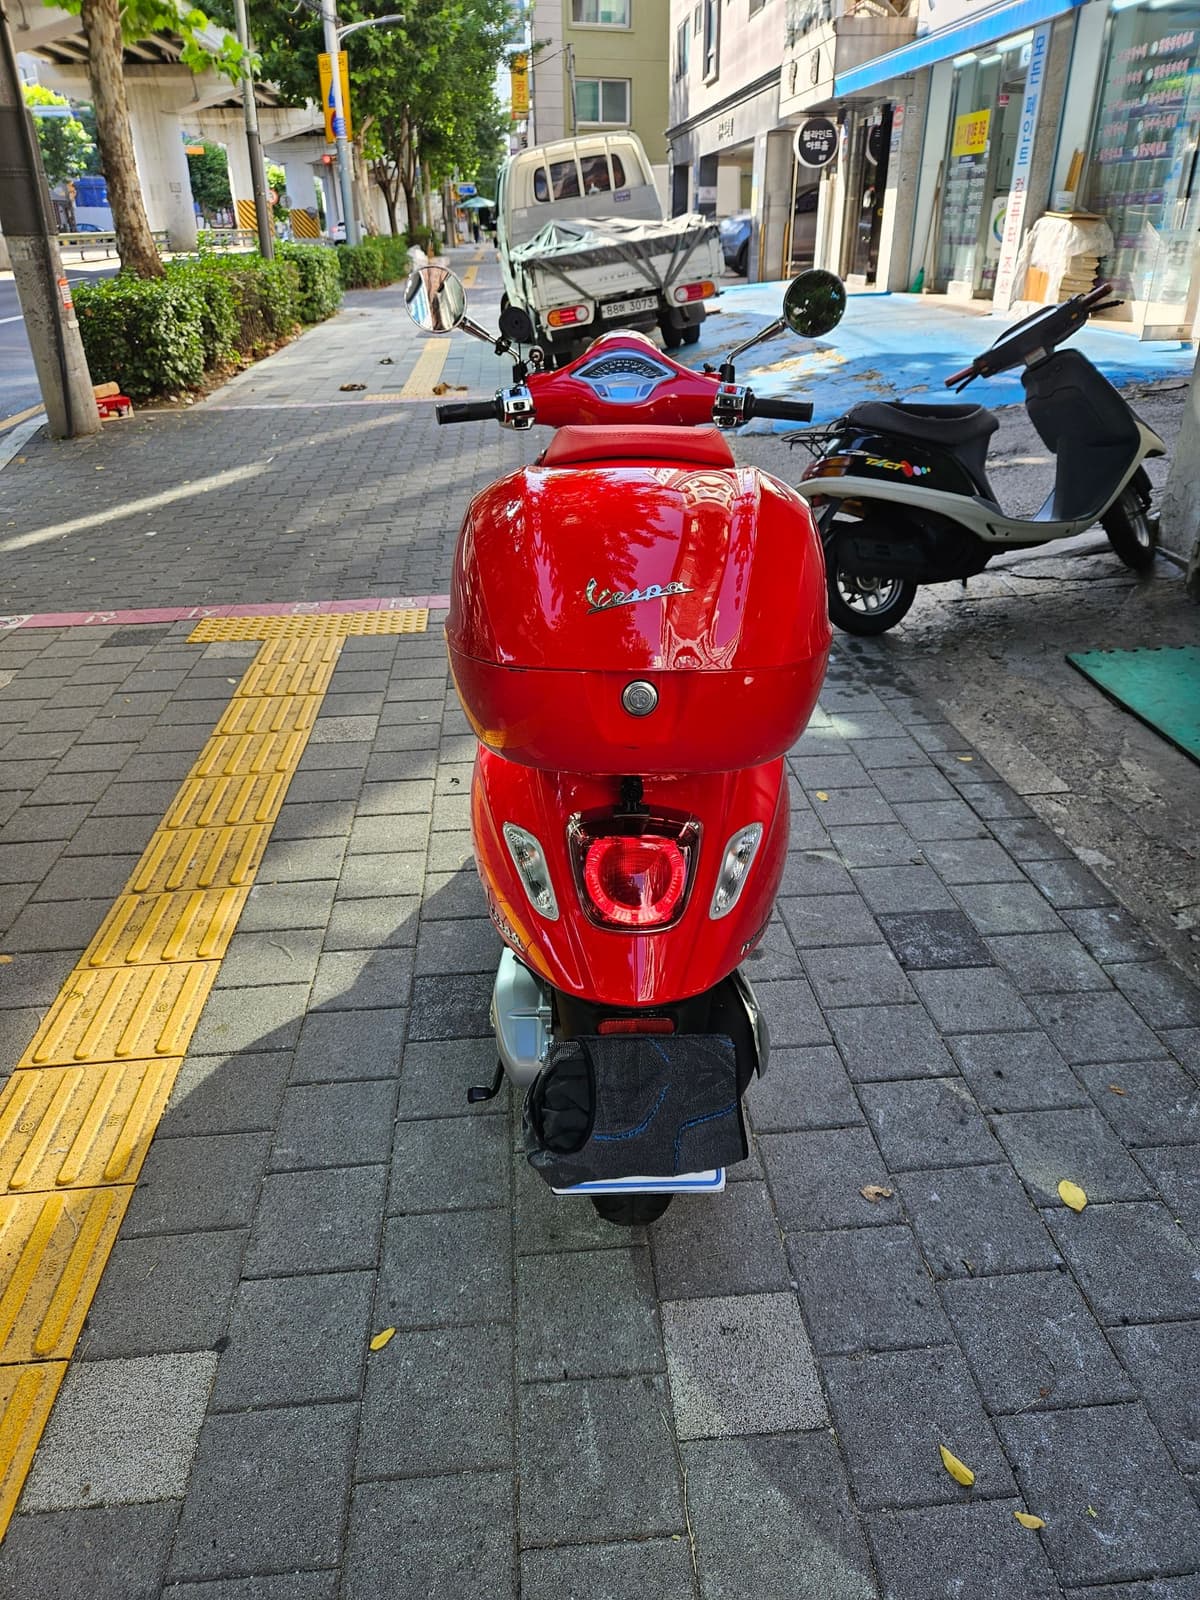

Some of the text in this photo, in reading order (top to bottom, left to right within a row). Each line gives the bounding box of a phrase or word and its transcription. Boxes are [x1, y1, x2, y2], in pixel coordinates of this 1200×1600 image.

[803, 130, 833, 141] 블라인드
[630, 297, 654, 311] 3073
[865, 457, 905, 470] TACT
[586, 578, 694, 614] Vespa
